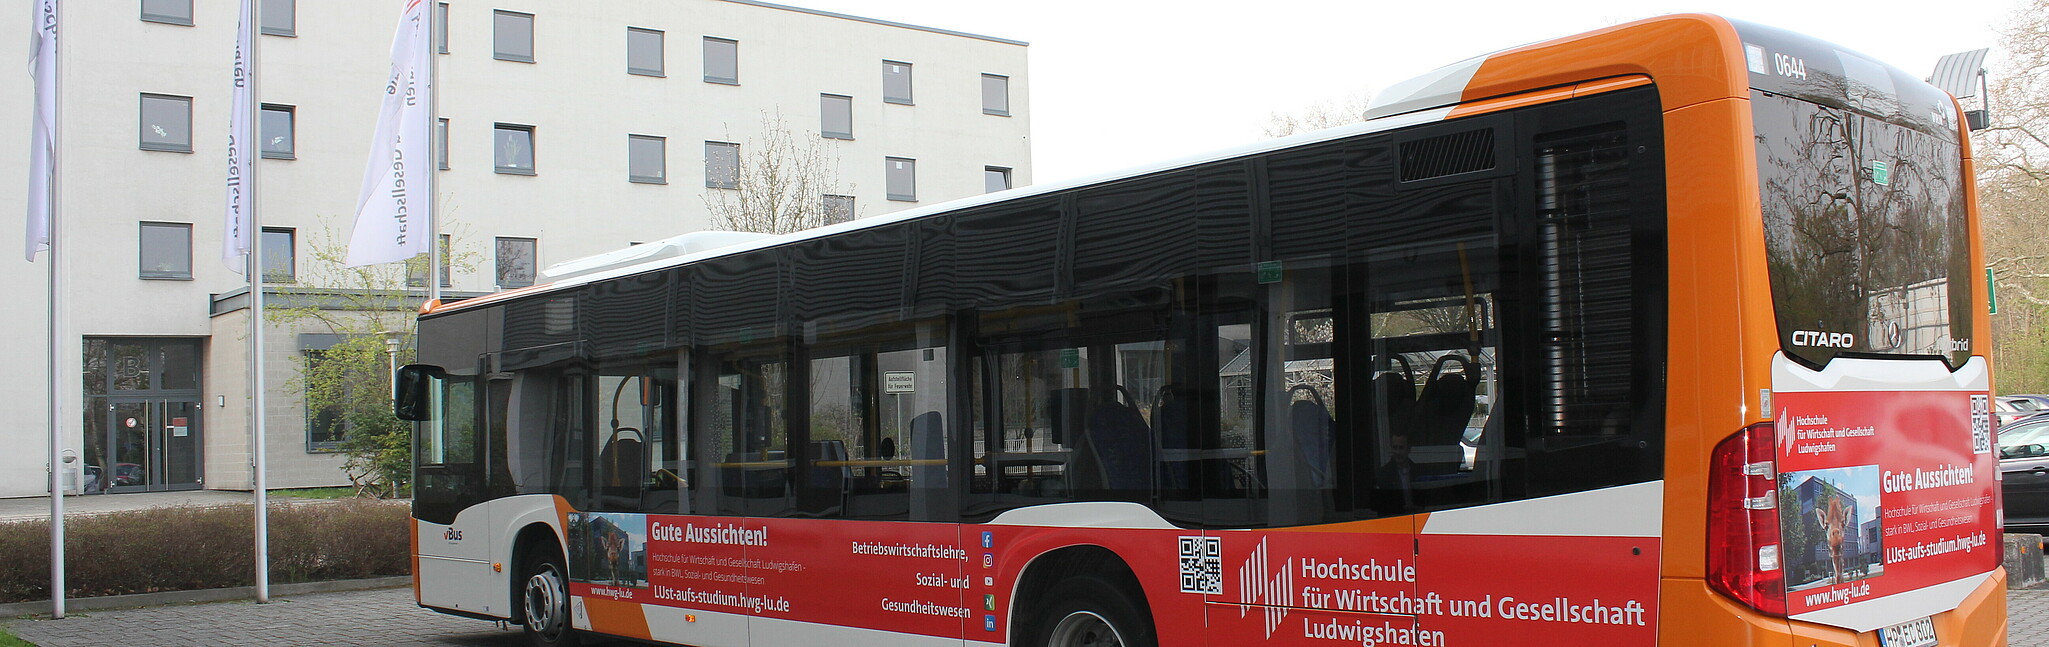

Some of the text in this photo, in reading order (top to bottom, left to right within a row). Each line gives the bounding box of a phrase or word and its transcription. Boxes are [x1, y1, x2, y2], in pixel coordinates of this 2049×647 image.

[1774, 52, 1807, 81] 0644
[1791, 330, 1854, 349] CITARO
[123, 355, 141, 377] B
[1796, 414, 1828, 426] Hochschule
[1797, 425, 1875, 440] für Wirtschaft und Gesellschaft
[1797, 441, 1836, 456] Ludwigshafen
[1883, 462, 1974, 494] Gute Aussichten!
[1884, 505, 1912, 519] Hochschule
[651, 521, 768, 547] Gute Aussichten!
[1885, 526, 1898, 537] stark
[1897, 524, 1903, 535] in
[852, 541, 969, 563] Betriebswirtschaftslehre,
[1886, 530, 1987, 565] LUst-aufs-studium.hwg-lu.de
[652, 552, 681, 564] Hochschule
[680, 553, 689, 565] für
[689, 554, 716, 566] Wirtschaft
[715, 556, 728, 567] und
[727, 557, 762, 569] Gesellschaft
[761, 560, 802, 574] Ludwigshafen
[1301, 557, 1416, 583] Hochschule
[652, 567, 666, 577] stark
[665, 568, 671, 577] in
[684, 569, 701, 580] Sozial-
[701, 570, 713, 581] und
[712, 571, 765, 585] Gesundheitswesen
[916, 572, 970, 589] Sozial- und
[590, 586, 633, 600] www.hwg-lu.de
[653, 585, 790, 614] LUst-aufs-studium.hwg-lu.de
[1805, 580, 1870, 605] www.hwg-lu.de
[881, 597, 971, 619] Gesundheitswesen
[1301, 586, 1646, 626] für Wirtschaft und Gesellschaft
[1303, 617, 1445, 647] Ludwigshafen
[1915, 619, 1934, 642] 802
